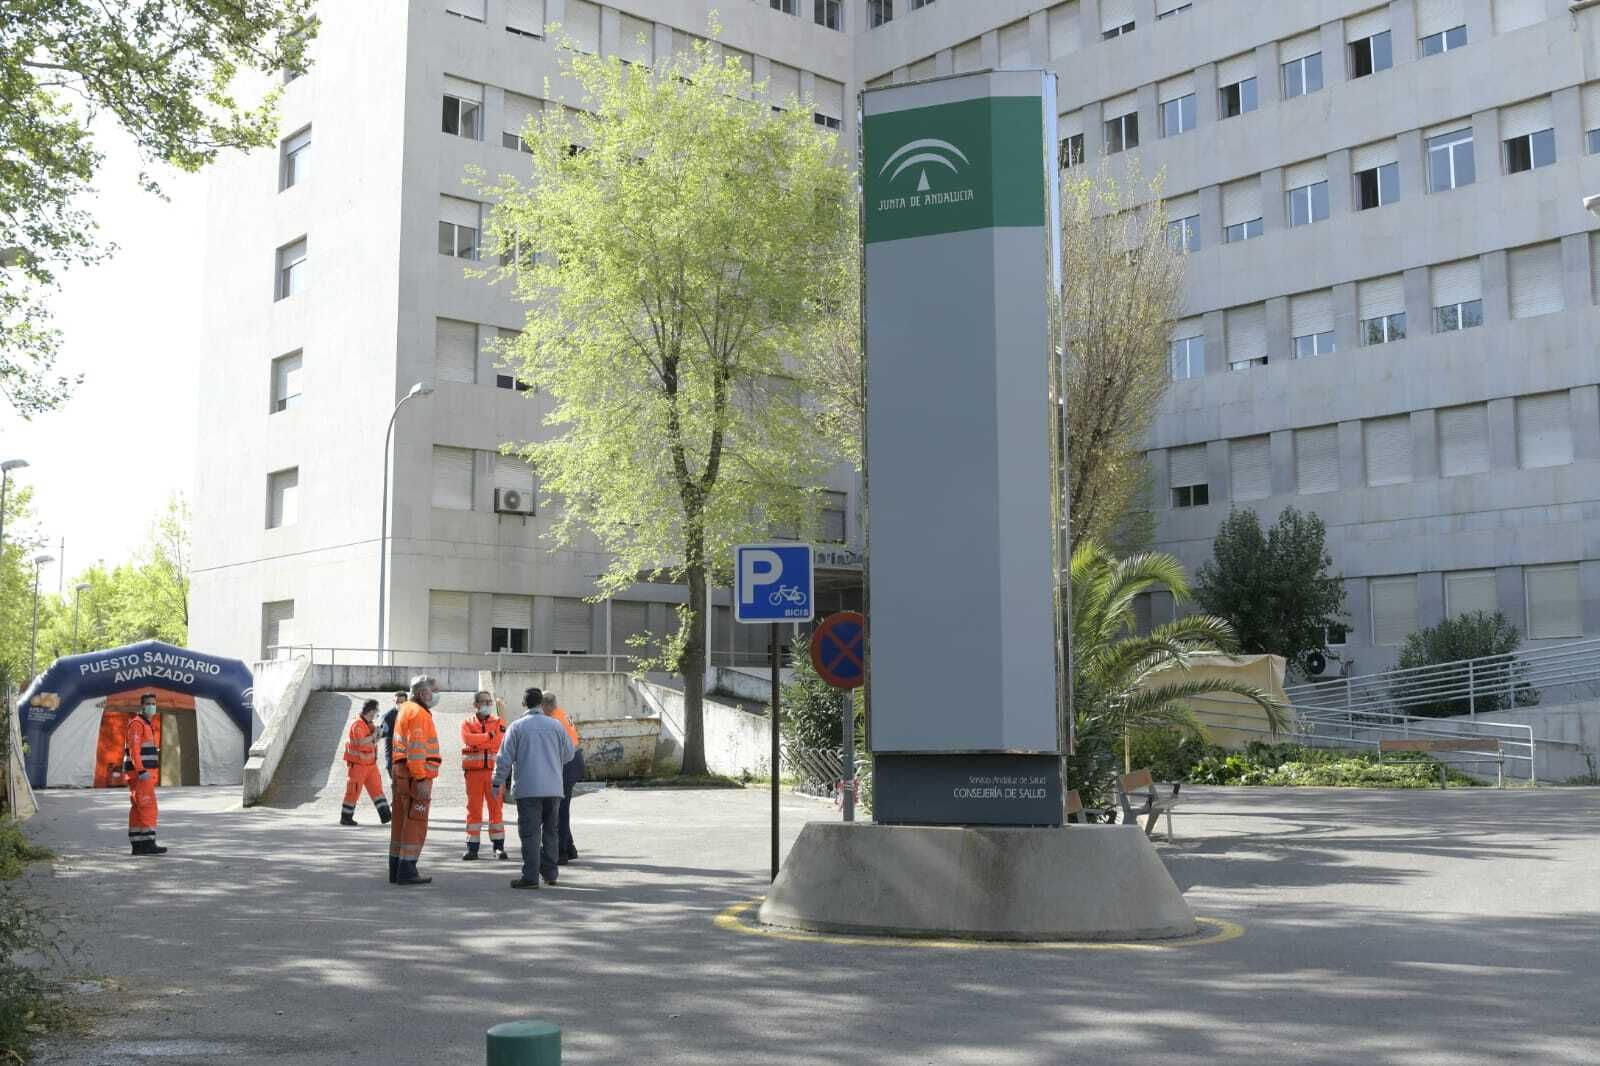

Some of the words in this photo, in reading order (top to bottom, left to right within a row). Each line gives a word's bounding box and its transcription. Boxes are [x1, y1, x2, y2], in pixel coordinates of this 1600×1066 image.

[878, 198, 906, 211] JUNTA
[910, 196, 921, 207] DE
[742, 550, 783, 604] P
[785, 608, 809, 617] BICIS
[79, 654, 140, 675] PUESTO
[143, 651, 221, 676] SANITARIO
[113, 665, 195, 685] AVANZADO
[993, 775, 1017, 785] Andaluz
[1018, 775, 1028, 785] de
[1029, 775, 1046, 785] Salud
[1004, 788, 1017, 799] DE
[1018, 788, 1047, 799] SALUD
